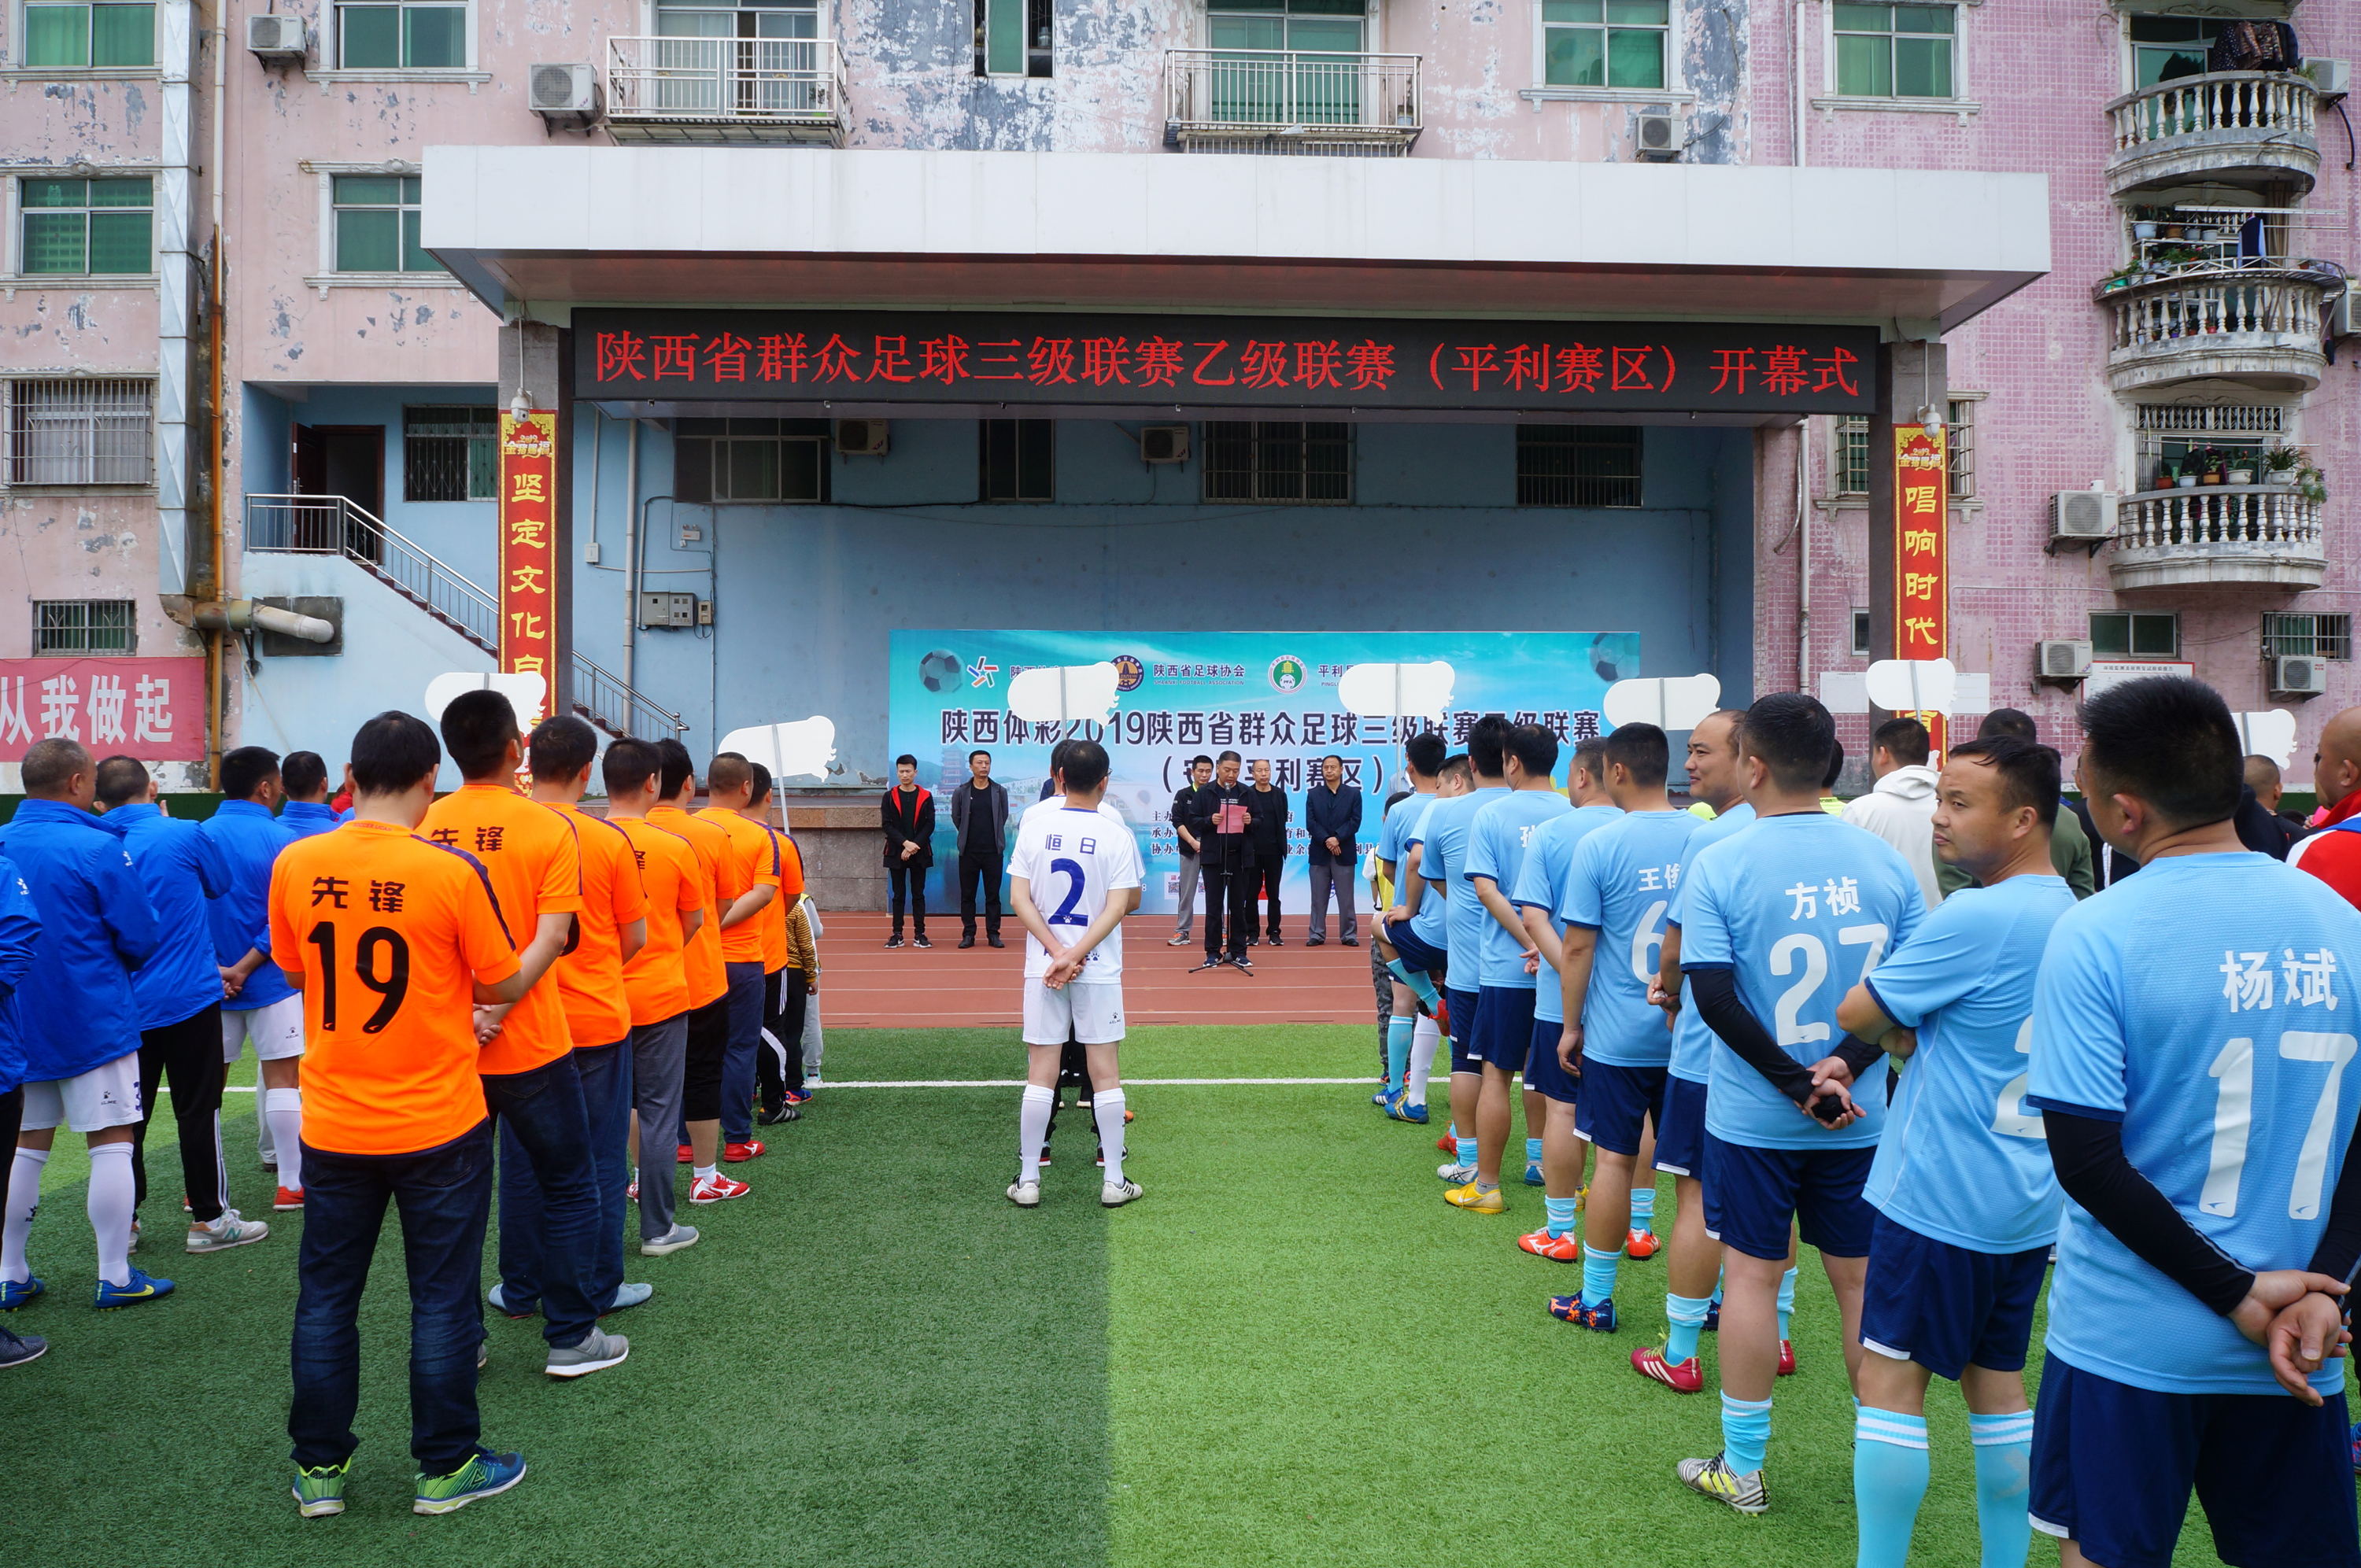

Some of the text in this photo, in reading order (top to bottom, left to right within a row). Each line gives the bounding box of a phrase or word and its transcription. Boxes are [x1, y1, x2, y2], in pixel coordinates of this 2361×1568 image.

[598, 331, 1857, 395] 陕西省群众足球三级联赛乙级联赛（平利赛区）开幕式
[511, 474, 546, 729] 坚定文化自
[1154, 664, 1245, 677] 陕西省足球协会
[0, 674, 173, 745] 从我做起
[430, 826, 504, 851] 先锋
[1045, 834, 1097, 855] 恒日
[312, 876, 405, 913] 先锋
[1047, 858, 1089, 927] 2
[1785, 876, 1862, 921] 方祯
[307, 921, 409, 1034] 19
[1769, 923, 1889, 1046] 27
[2219, 947, 2339, 1013] 杨斌
[2197, 1031, 2359, 1220] 17
